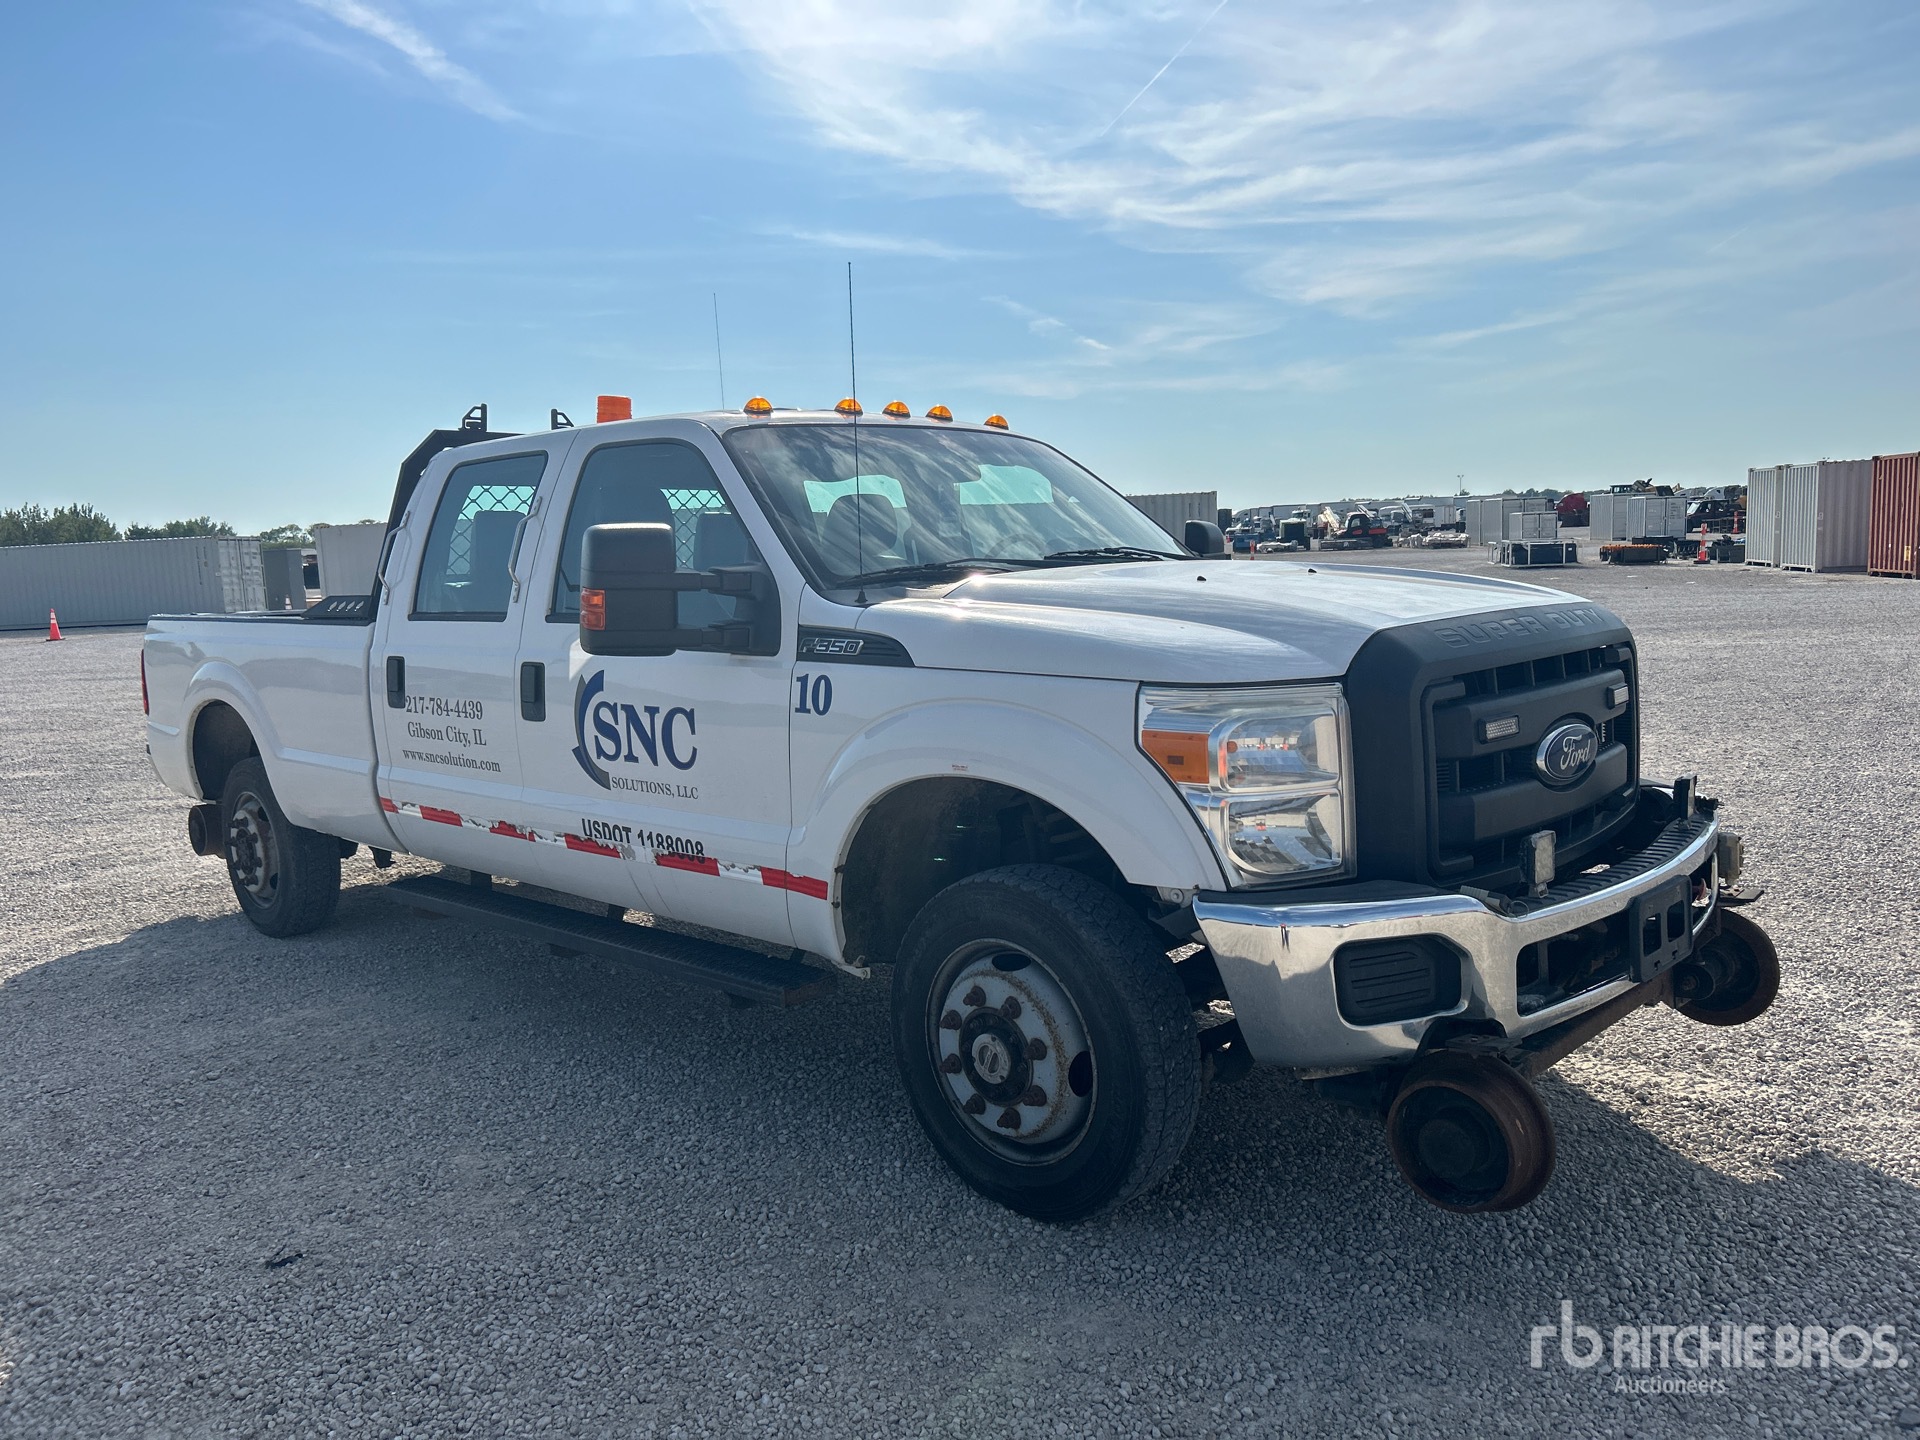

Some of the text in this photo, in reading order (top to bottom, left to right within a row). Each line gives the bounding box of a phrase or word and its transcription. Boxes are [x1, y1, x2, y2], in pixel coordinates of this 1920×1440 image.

[1434, 608, 1604, 649] SUPER DUTY
[405, 695, 483, 720] 217-784-4439
[794, 673, 833, 716] 10
[408, 721, 487, 748] Gibson City, IL
[593, 700, 698, 771] SNC
[1560, 734, 1591, 770] Ford
[402, 749, 501, 773] www.sncsolution.com
[611, 777, 699, 800] SOLUTIONS, LLC
[581, 818, 706, 864] USDOT 1188008
